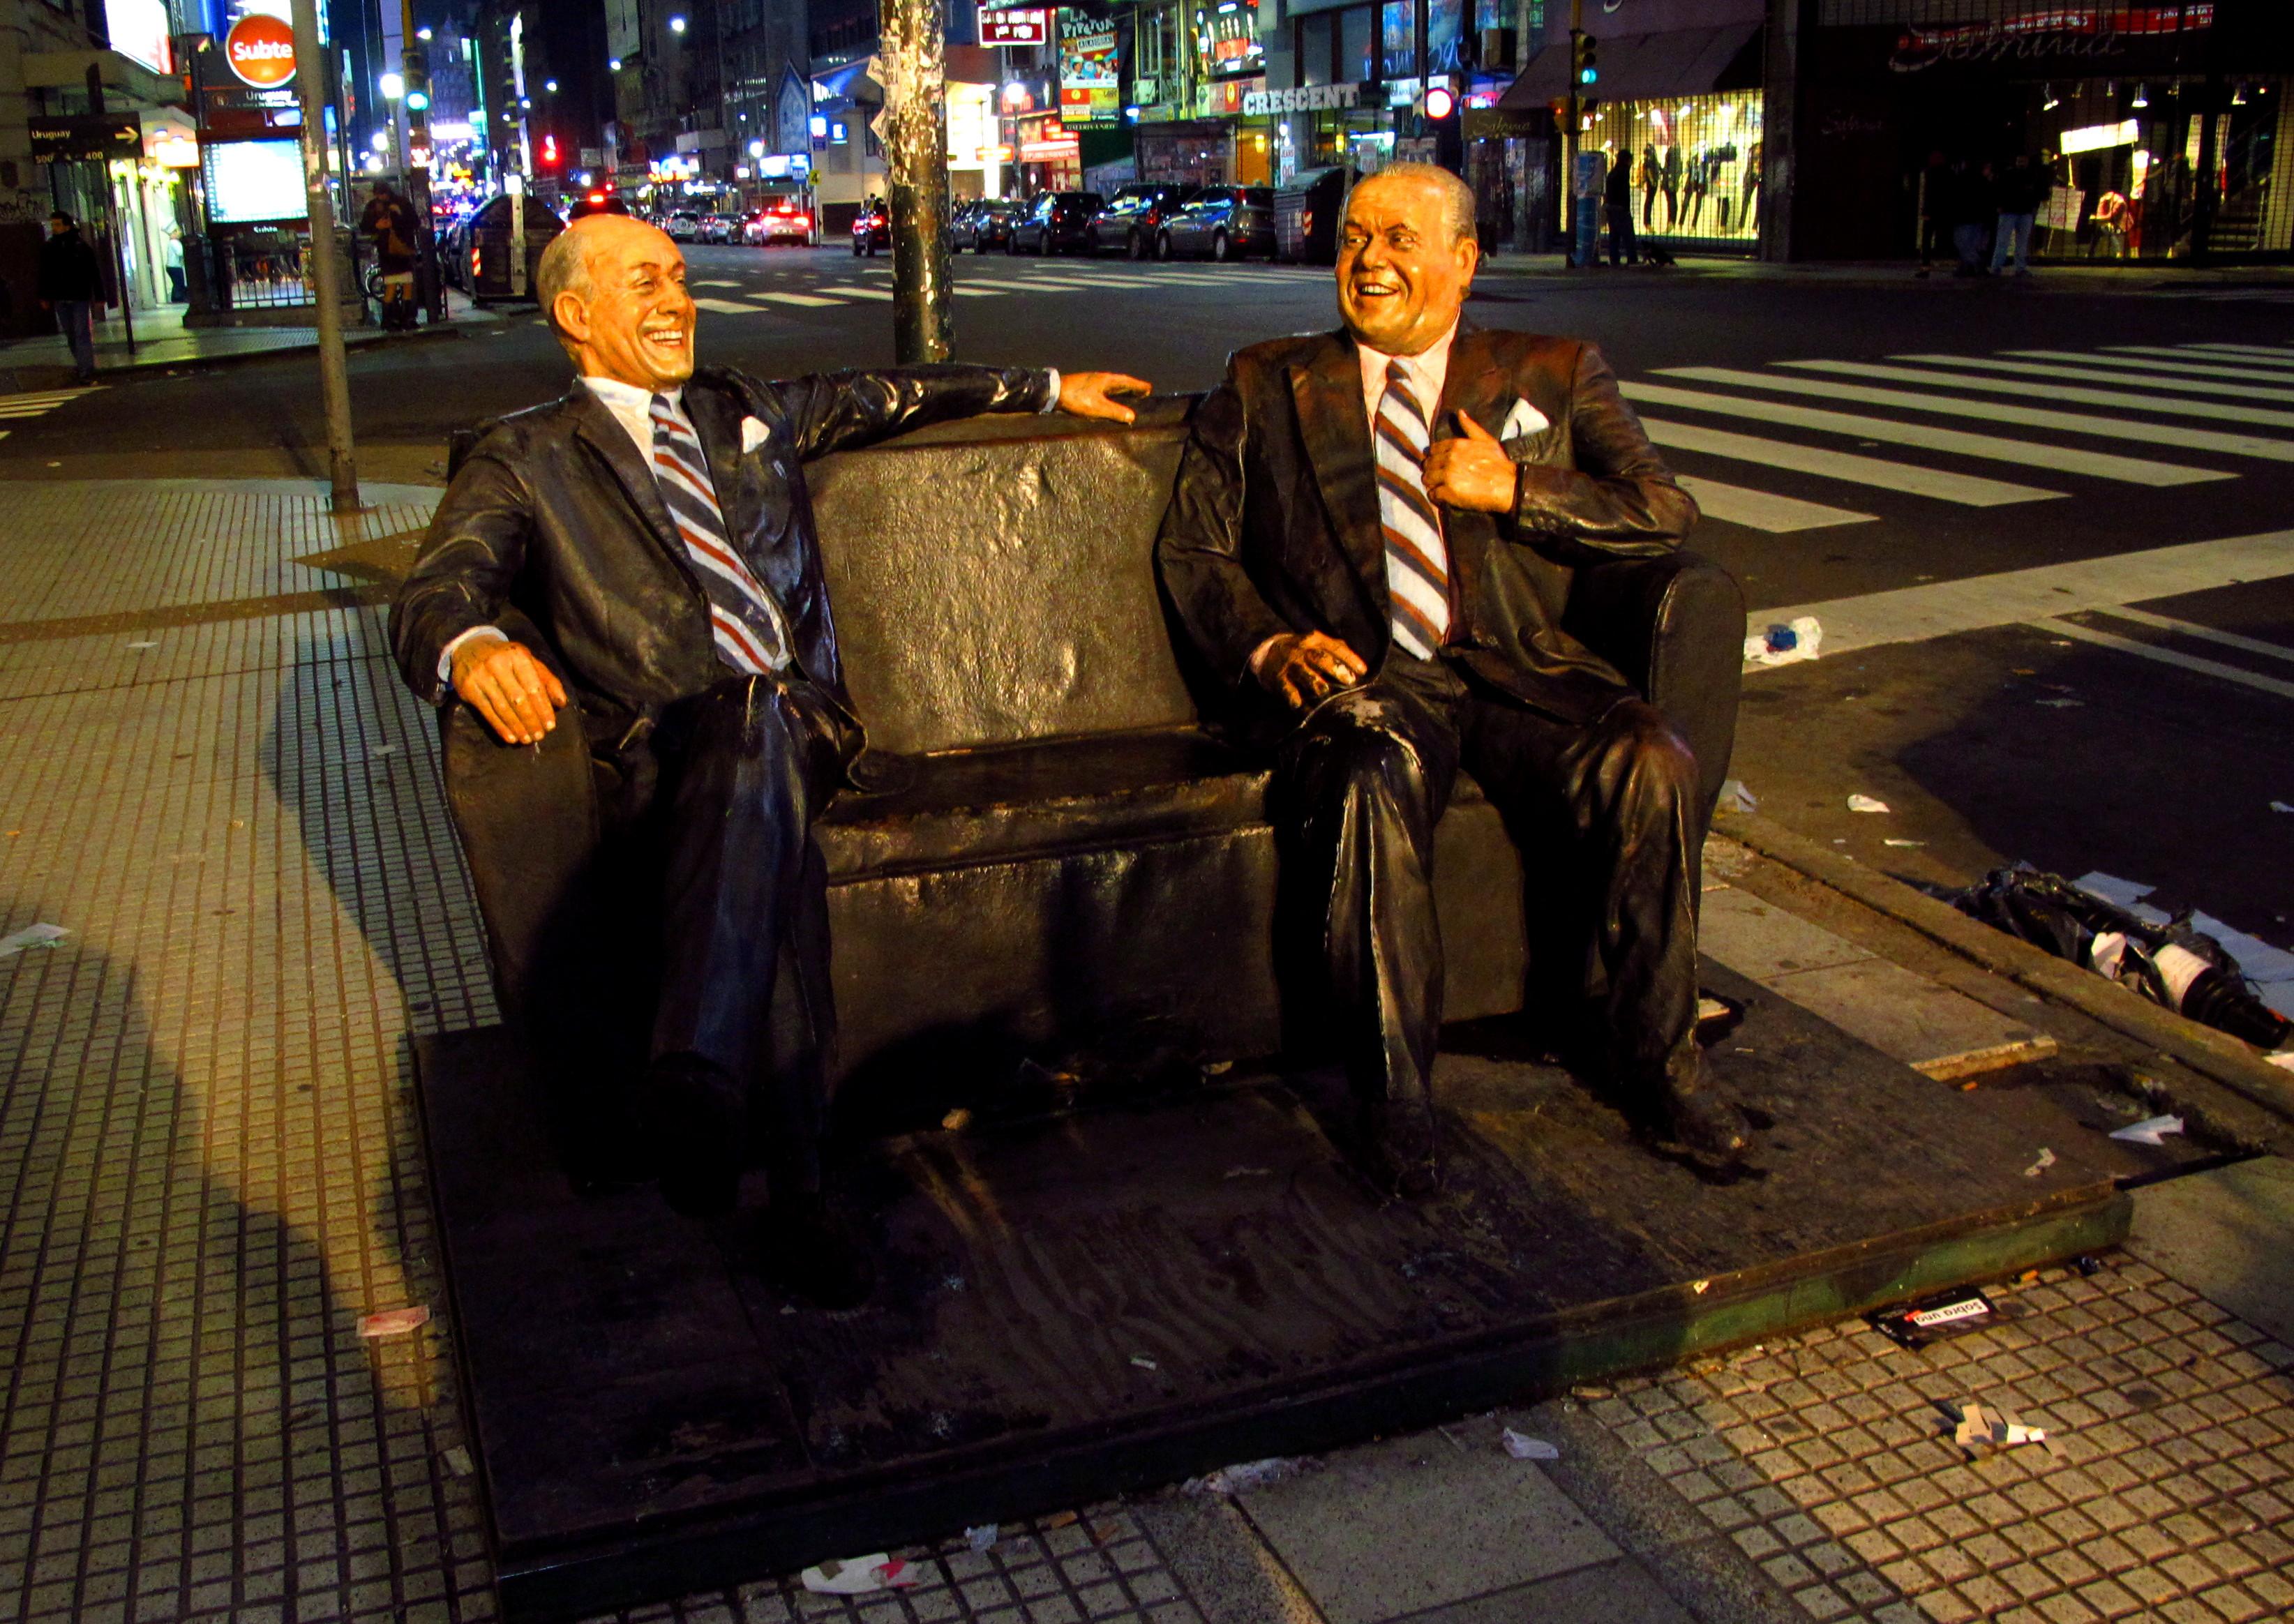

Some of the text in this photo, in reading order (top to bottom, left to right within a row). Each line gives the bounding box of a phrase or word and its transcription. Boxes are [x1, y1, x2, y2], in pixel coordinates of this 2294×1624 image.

[233, 39, 293, 61] Subte
[1243, 84, 1358, 116] CRESCENT
[31, 129, 70, 140] Uruguay
[85, 151, 103, 160] 400
